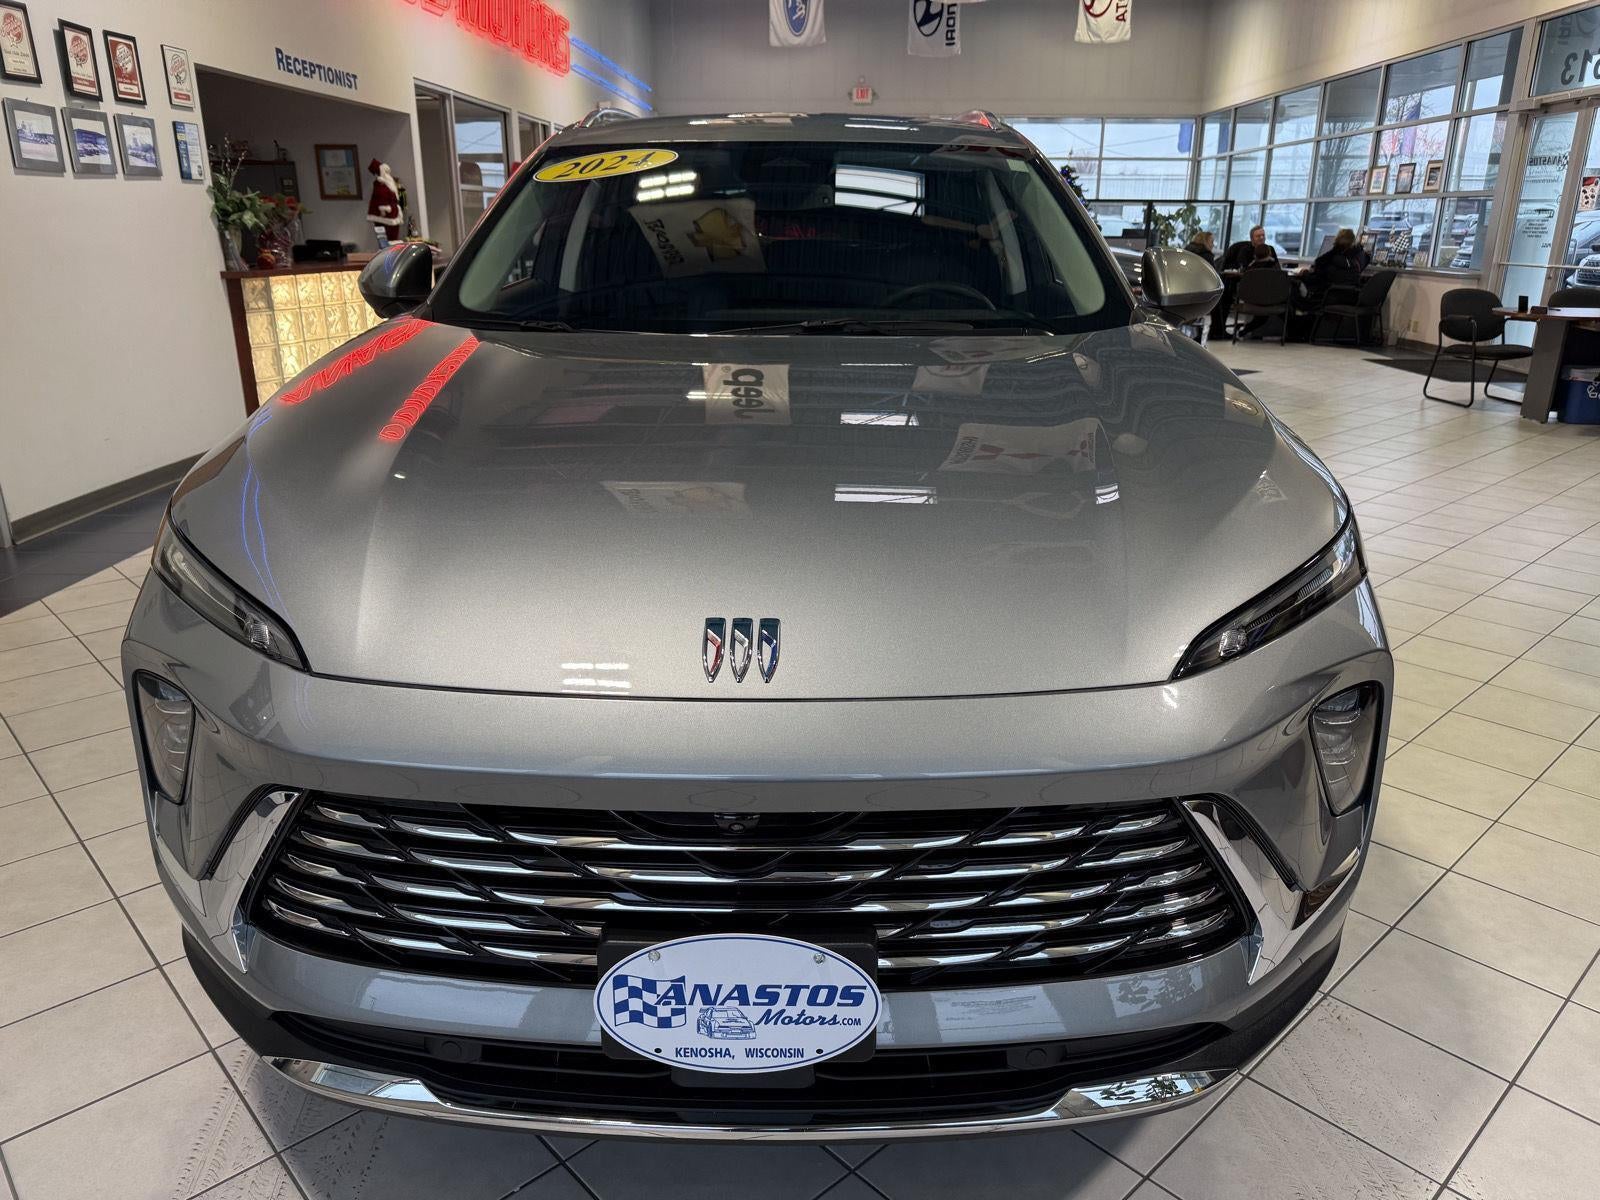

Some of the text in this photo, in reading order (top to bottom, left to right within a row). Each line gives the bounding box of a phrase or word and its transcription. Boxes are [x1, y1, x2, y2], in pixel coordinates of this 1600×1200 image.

[275, 47, 358, 90] RECEPTIONIST
[552, 151, 656, 179] 2024
[654, 983, 868, 1007] ANASTOS
[675, 1047, 805, 1060] KENOSHA, WISCONSIN
